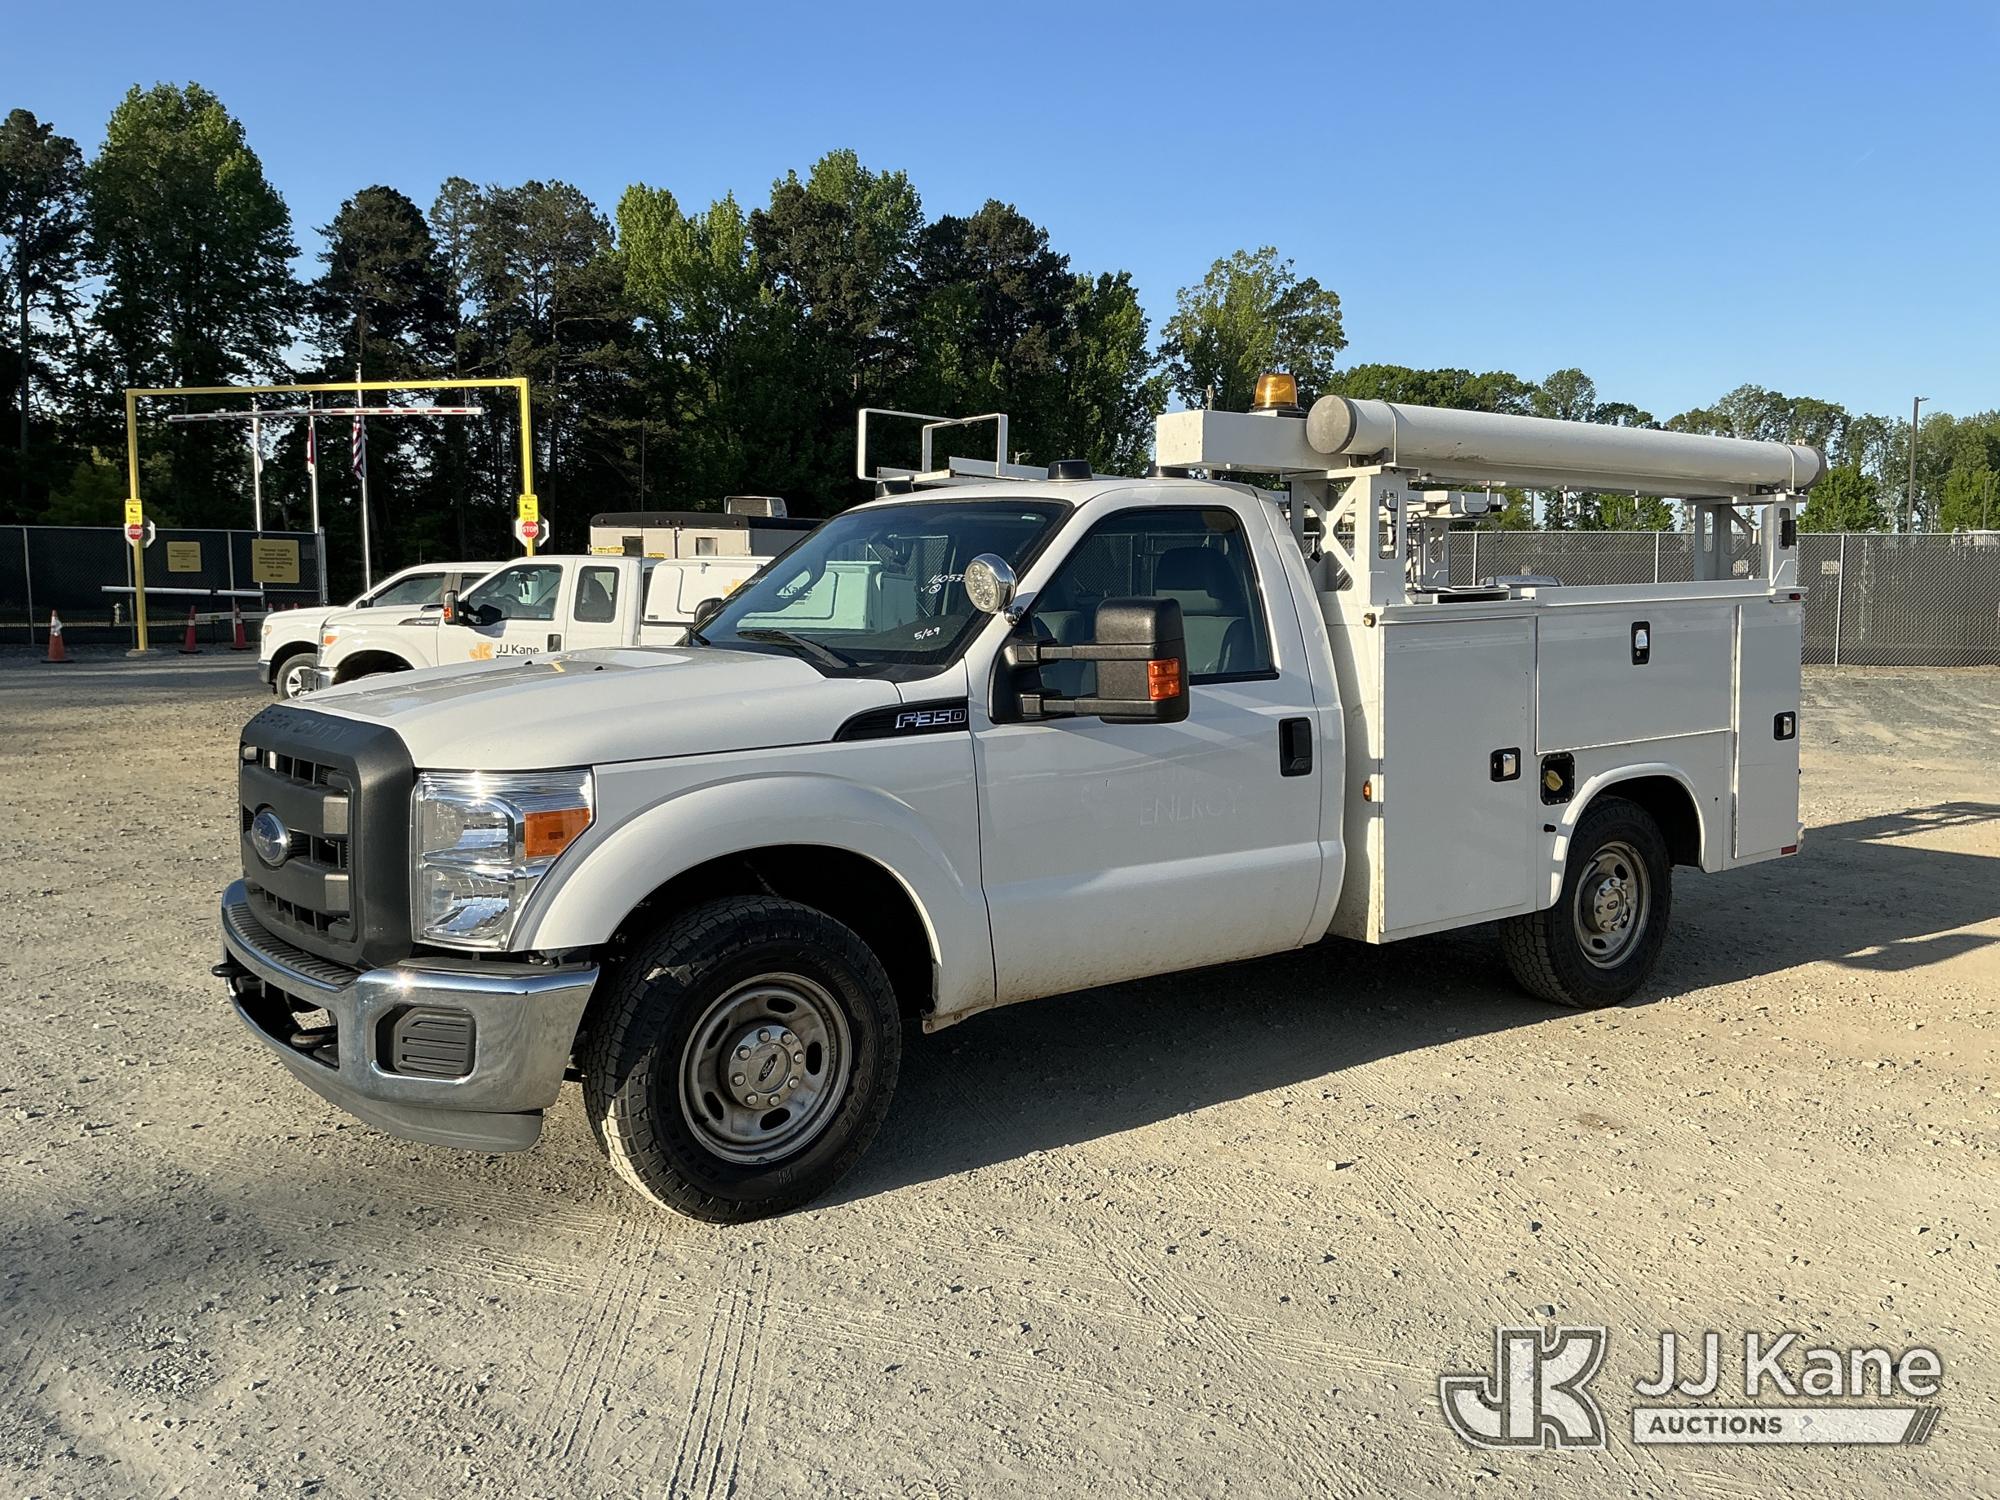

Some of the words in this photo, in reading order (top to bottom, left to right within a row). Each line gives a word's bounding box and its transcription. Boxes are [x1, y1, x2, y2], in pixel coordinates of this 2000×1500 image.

[914, 626, 940, 640] 5/29
[496, 643, 508, 654] JJ
[511, 644, 540, 655] Kane
